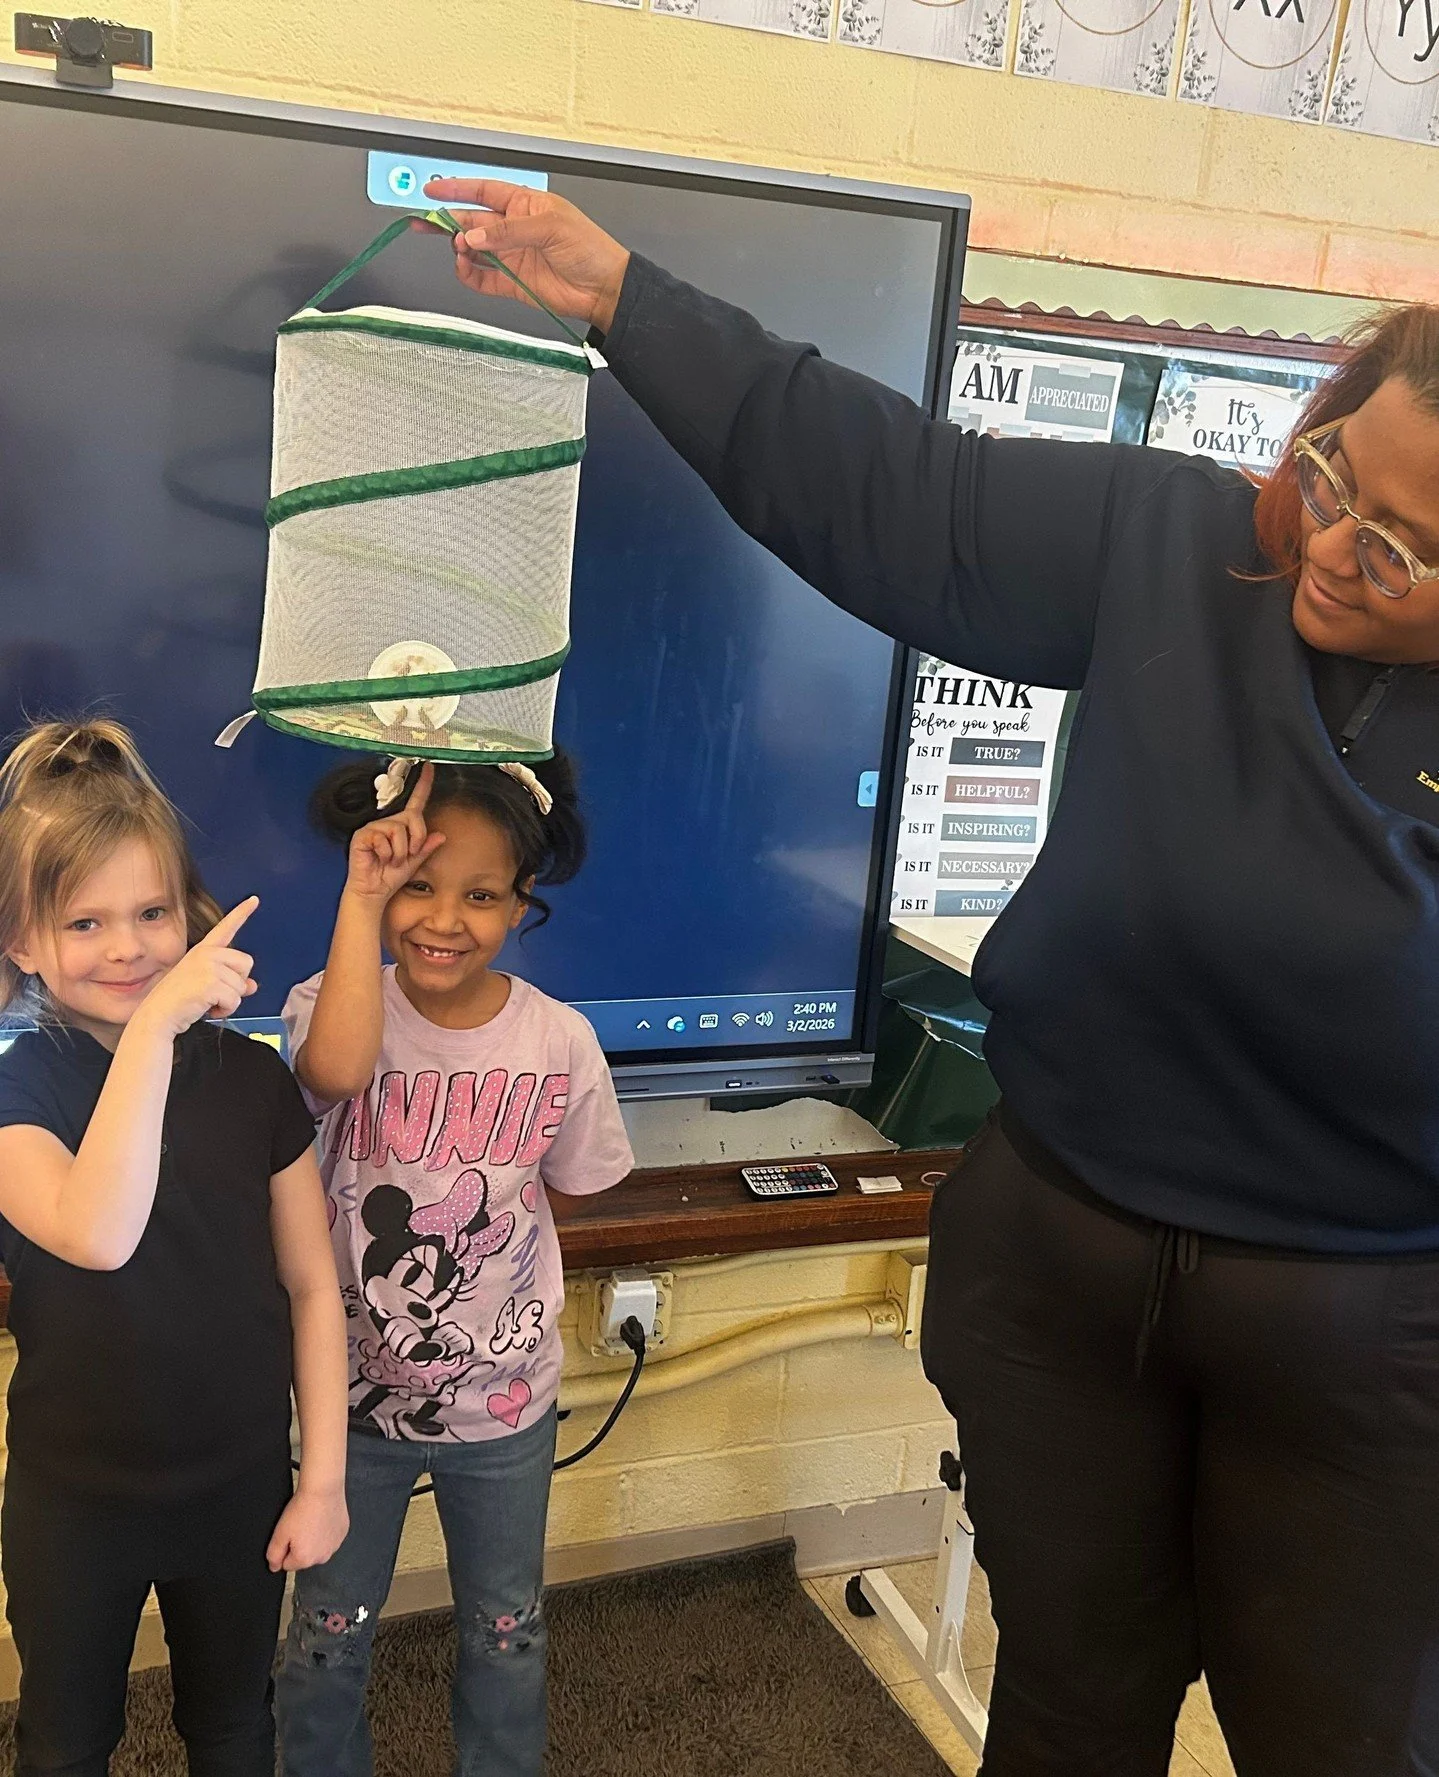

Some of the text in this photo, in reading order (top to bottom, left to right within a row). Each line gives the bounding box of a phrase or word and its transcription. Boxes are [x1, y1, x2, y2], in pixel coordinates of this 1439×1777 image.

[958, 363, 1024, 405] AM
[1029, 386, 1110, 413] APPRECIATED
[1227, 398, 1265, 436] It's
[1192, 428, 1251, 454] OKAY
[914, 676, 1033, 709] THINK
[911, 709, 1031, 738] Before you speak
[916, 746, 1021, 760] IS IT TRUE?
[911, 784, 1031, 799] IS IT HELPFUL?
[907, 822, 1031, 837] IS IT INSPIRING?
[904, 860, 1030, 874] IS IT NECESSARY?
[900, 898, 1003, 911] IS IT KIND?
[793, 1002, 837, 1015] 2:40 PM
[786, 1018, 836, 1033] 3/2/2026
